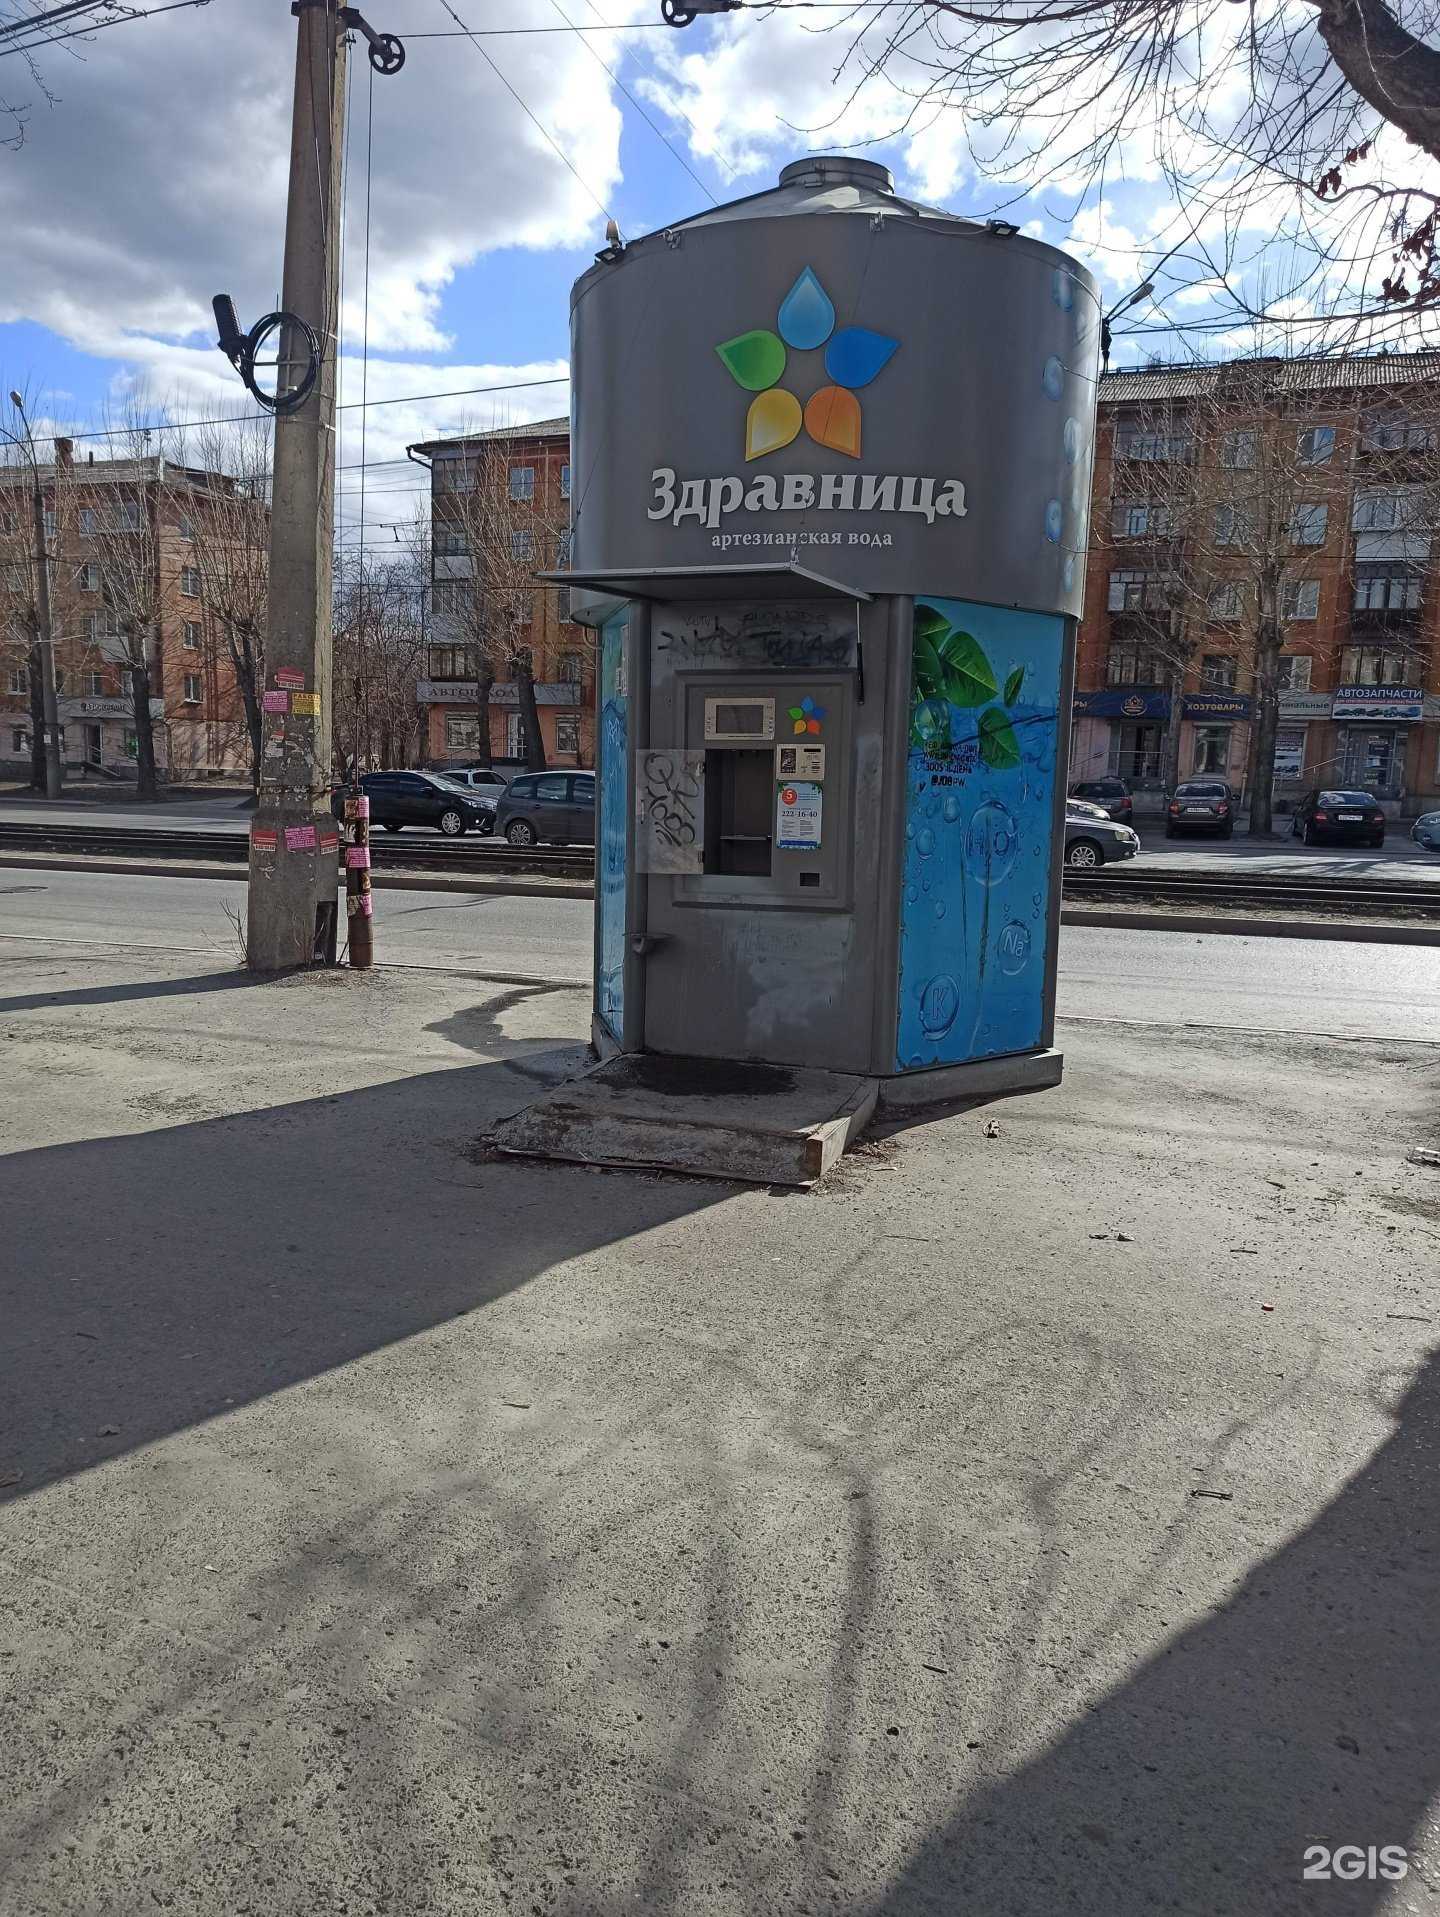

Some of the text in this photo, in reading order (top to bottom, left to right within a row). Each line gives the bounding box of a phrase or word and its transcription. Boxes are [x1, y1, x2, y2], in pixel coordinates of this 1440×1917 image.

[647, 467, 968, 528] Здравница
[711, 532, 893, 550] артезианская вода
[1336, 688, 1422, 698] АВТОЗАПЧАСТИ
[781, 810, 818, 818] 222-16-40
[1003, 930, 1024, 957] Na
